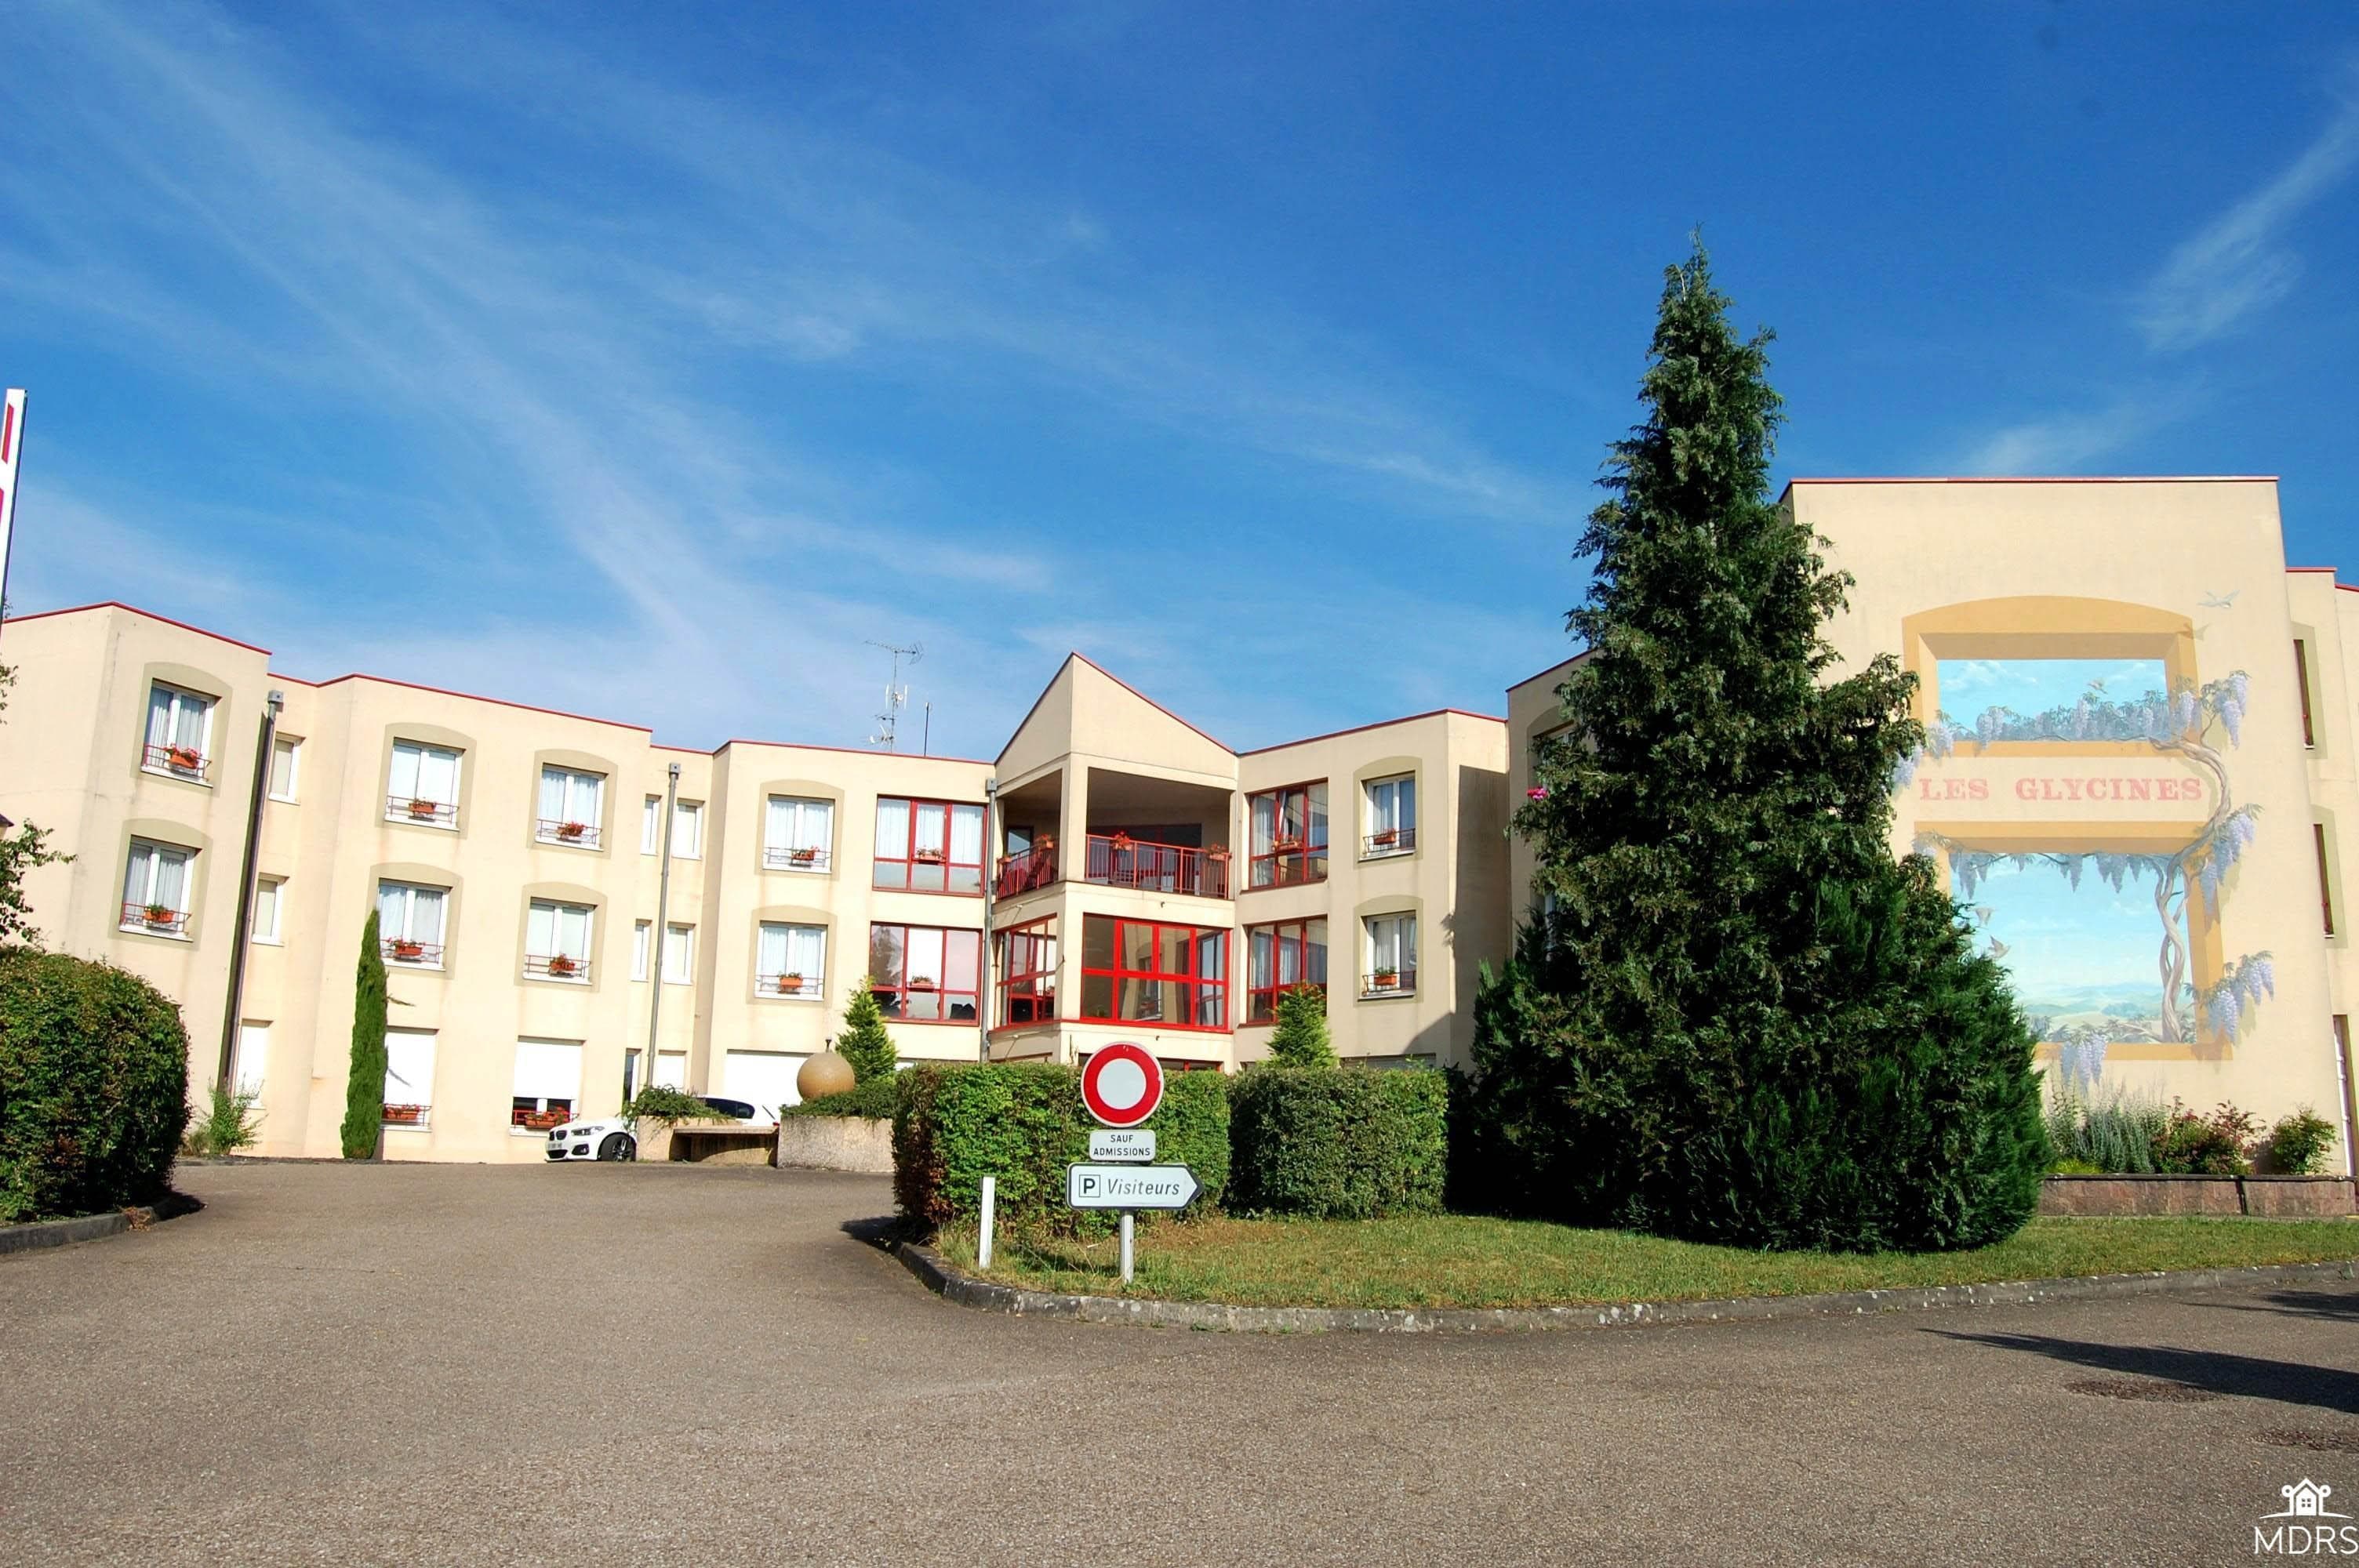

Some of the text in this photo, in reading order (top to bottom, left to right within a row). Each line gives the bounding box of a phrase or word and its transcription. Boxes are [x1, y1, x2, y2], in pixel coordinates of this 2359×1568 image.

[1918, 777, 2203, 800] LES GLYCINES
[1110, 1134, 1134, 1143] SAUF
[1092, 1147, 1151, 1156] ADMISSIONS
[1082, 1178, 1180, 1196] P Visiteurs
